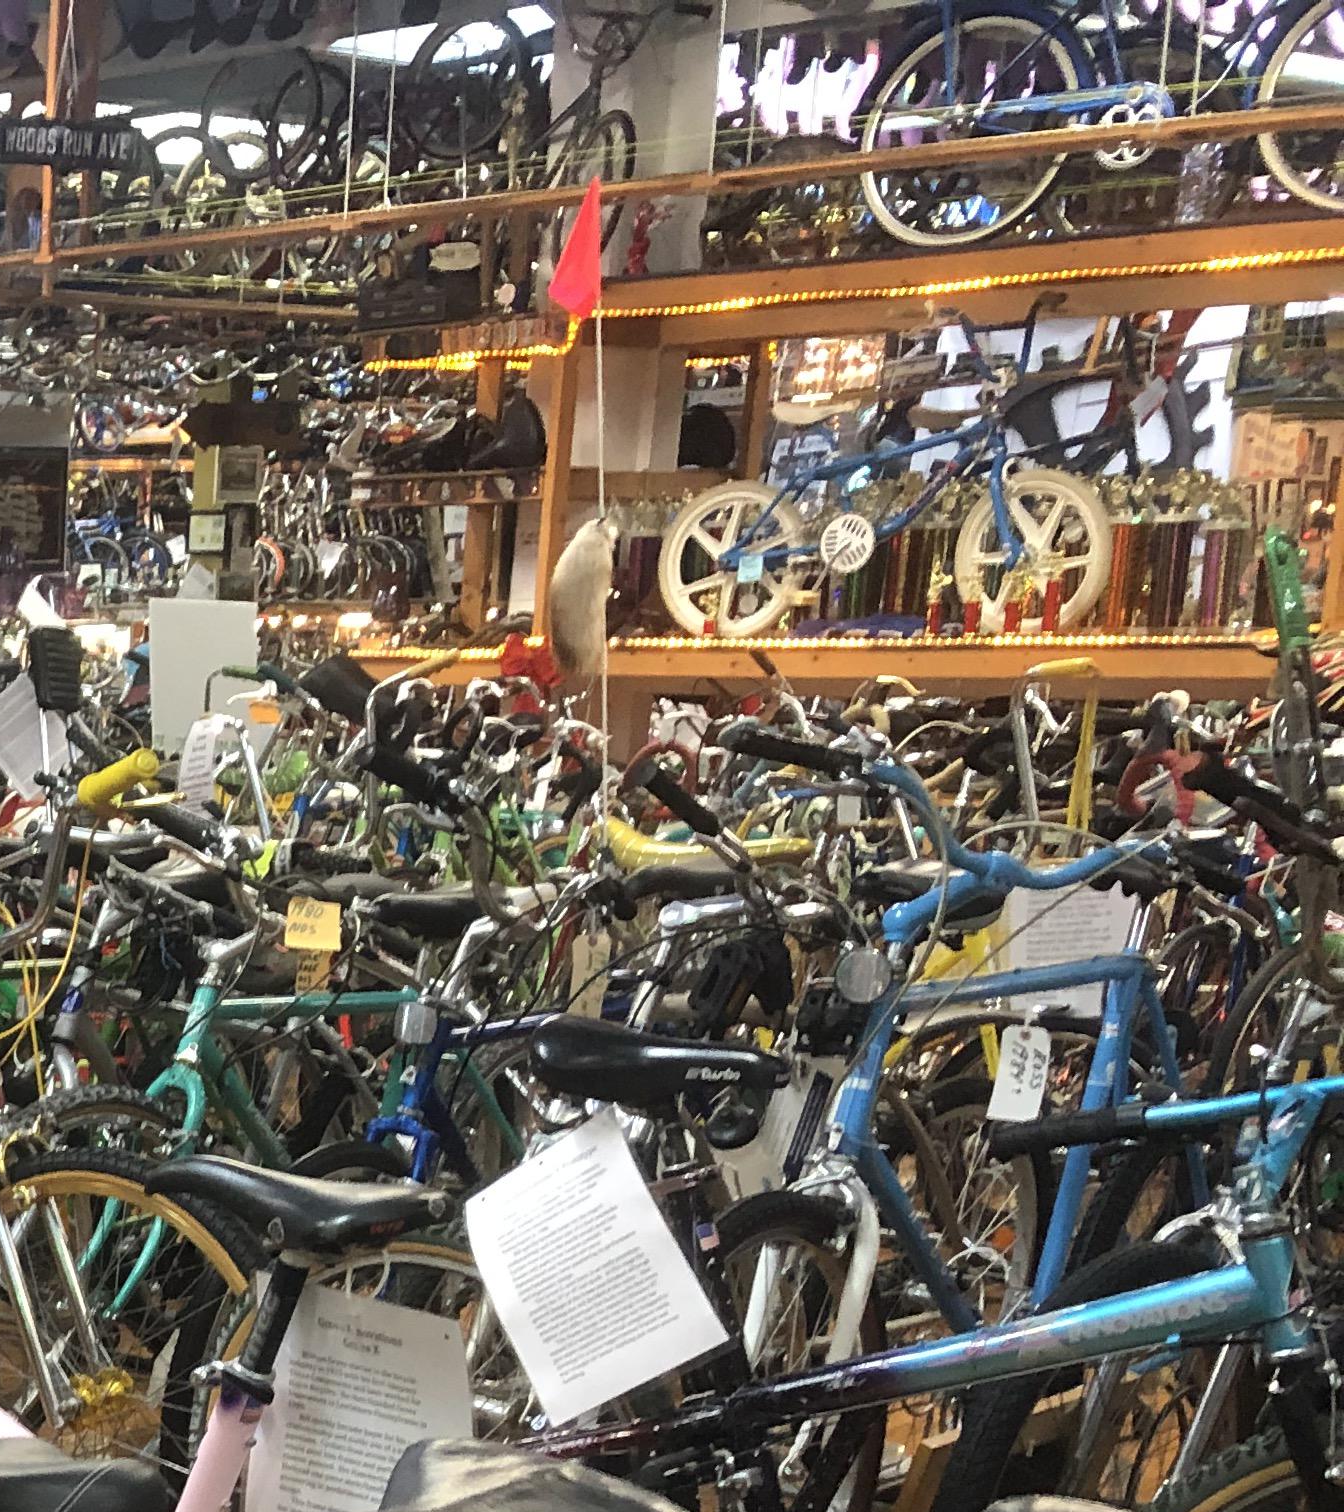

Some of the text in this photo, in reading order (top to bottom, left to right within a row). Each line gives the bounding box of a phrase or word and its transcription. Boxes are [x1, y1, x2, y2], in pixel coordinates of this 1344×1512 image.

[5, 126, 131, 160] WOODS RUN AVE
